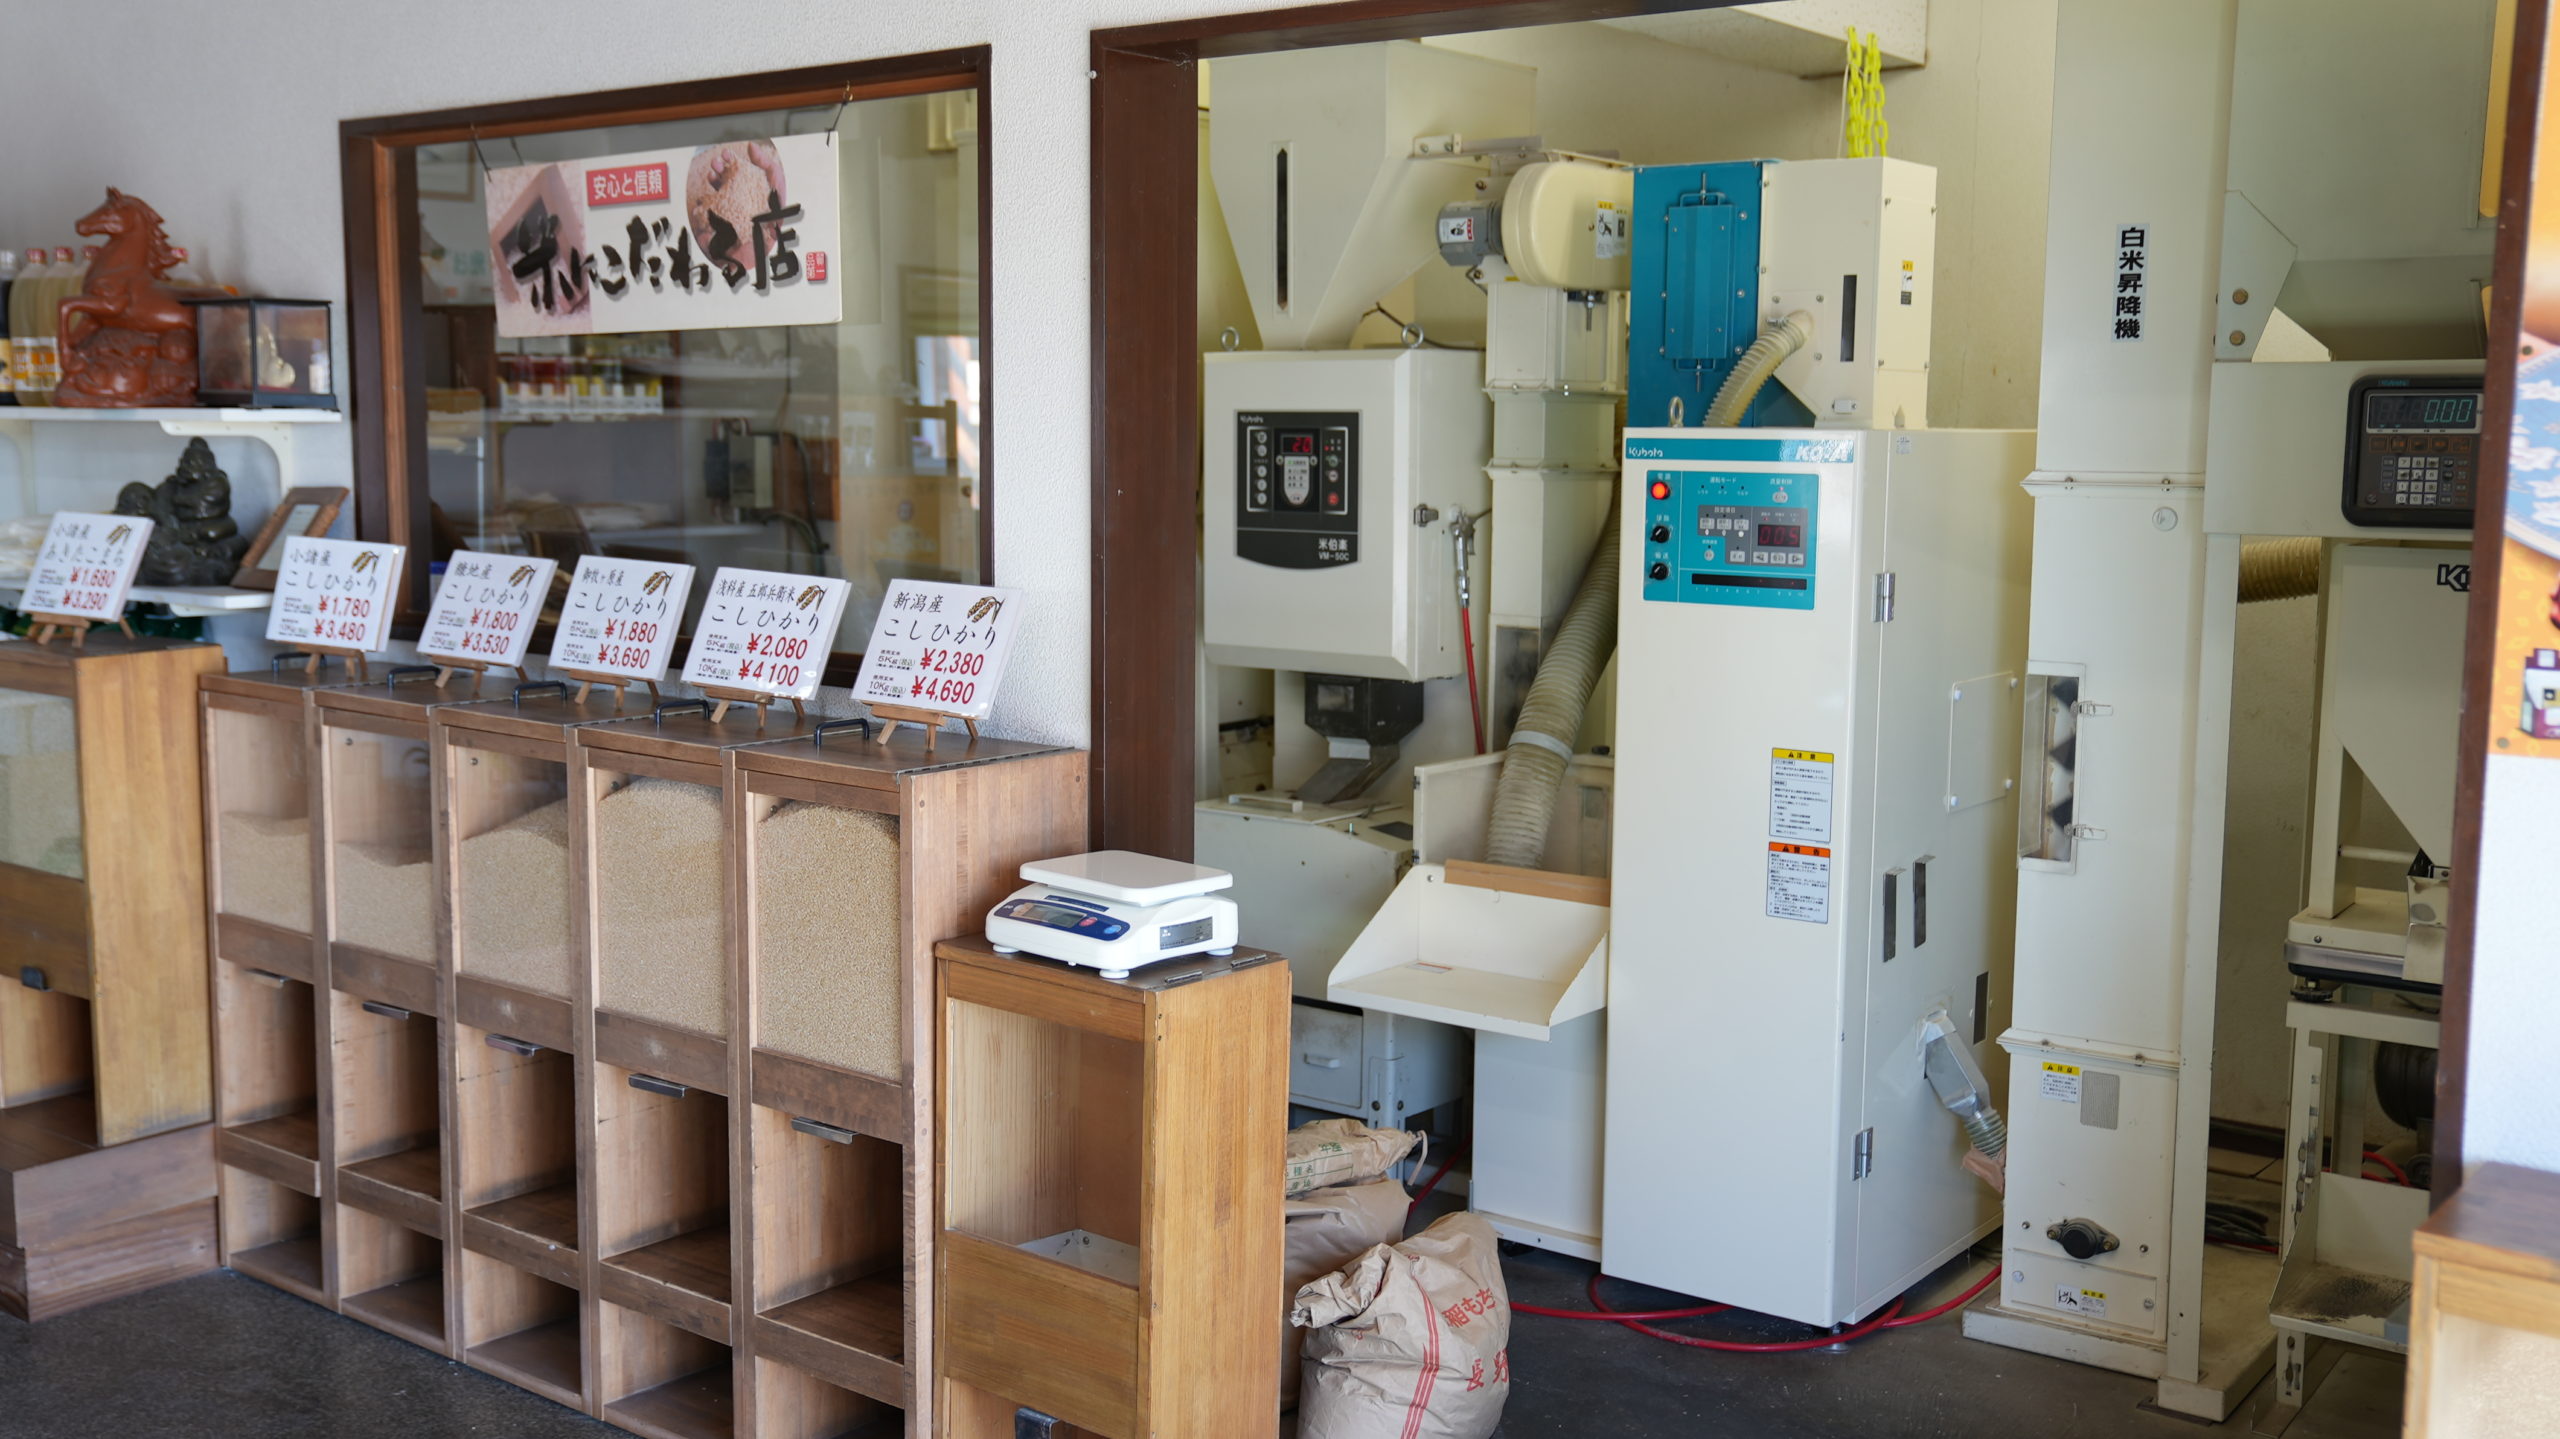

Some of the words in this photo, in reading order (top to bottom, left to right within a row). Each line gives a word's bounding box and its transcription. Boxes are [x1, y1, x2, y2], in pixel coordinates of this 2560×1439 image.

[593, 169, 664, 200] 安心と信頼
[512, 189, 801, 310] 米にこだわる店
[2114, 227, 2145, 339] 白米昇降機
[2424, 400, 2472, 422] 0.00
[1629, 447, 1664, 458] Kubota
[285, 570, 377, 596] こしひかり
[318, 595, 370, 618] ¥1,780
[445, 584, 529, 609] こしひかり
[575, 592, 667, 620] こしひかり
[893, 592, 944, 613] 新潟産
[313, 618, 366, 641] ¥3,480
[470, 607, 518, 631] ¥1,800
[604, 617, 657, 643] ¥1,880
[711, 604, 819, 636] こしひかり
[461, 631, 509, 655] ¥3,530
[747, 632, 808, 660] ¥2,080
[884, 618, 997, 650] こしひかり
[597, 643, 650, 669] ¥3,690
[920, 647, 984, 676] ¥2,380
[911, 675, 975, 705] ¥4,690
